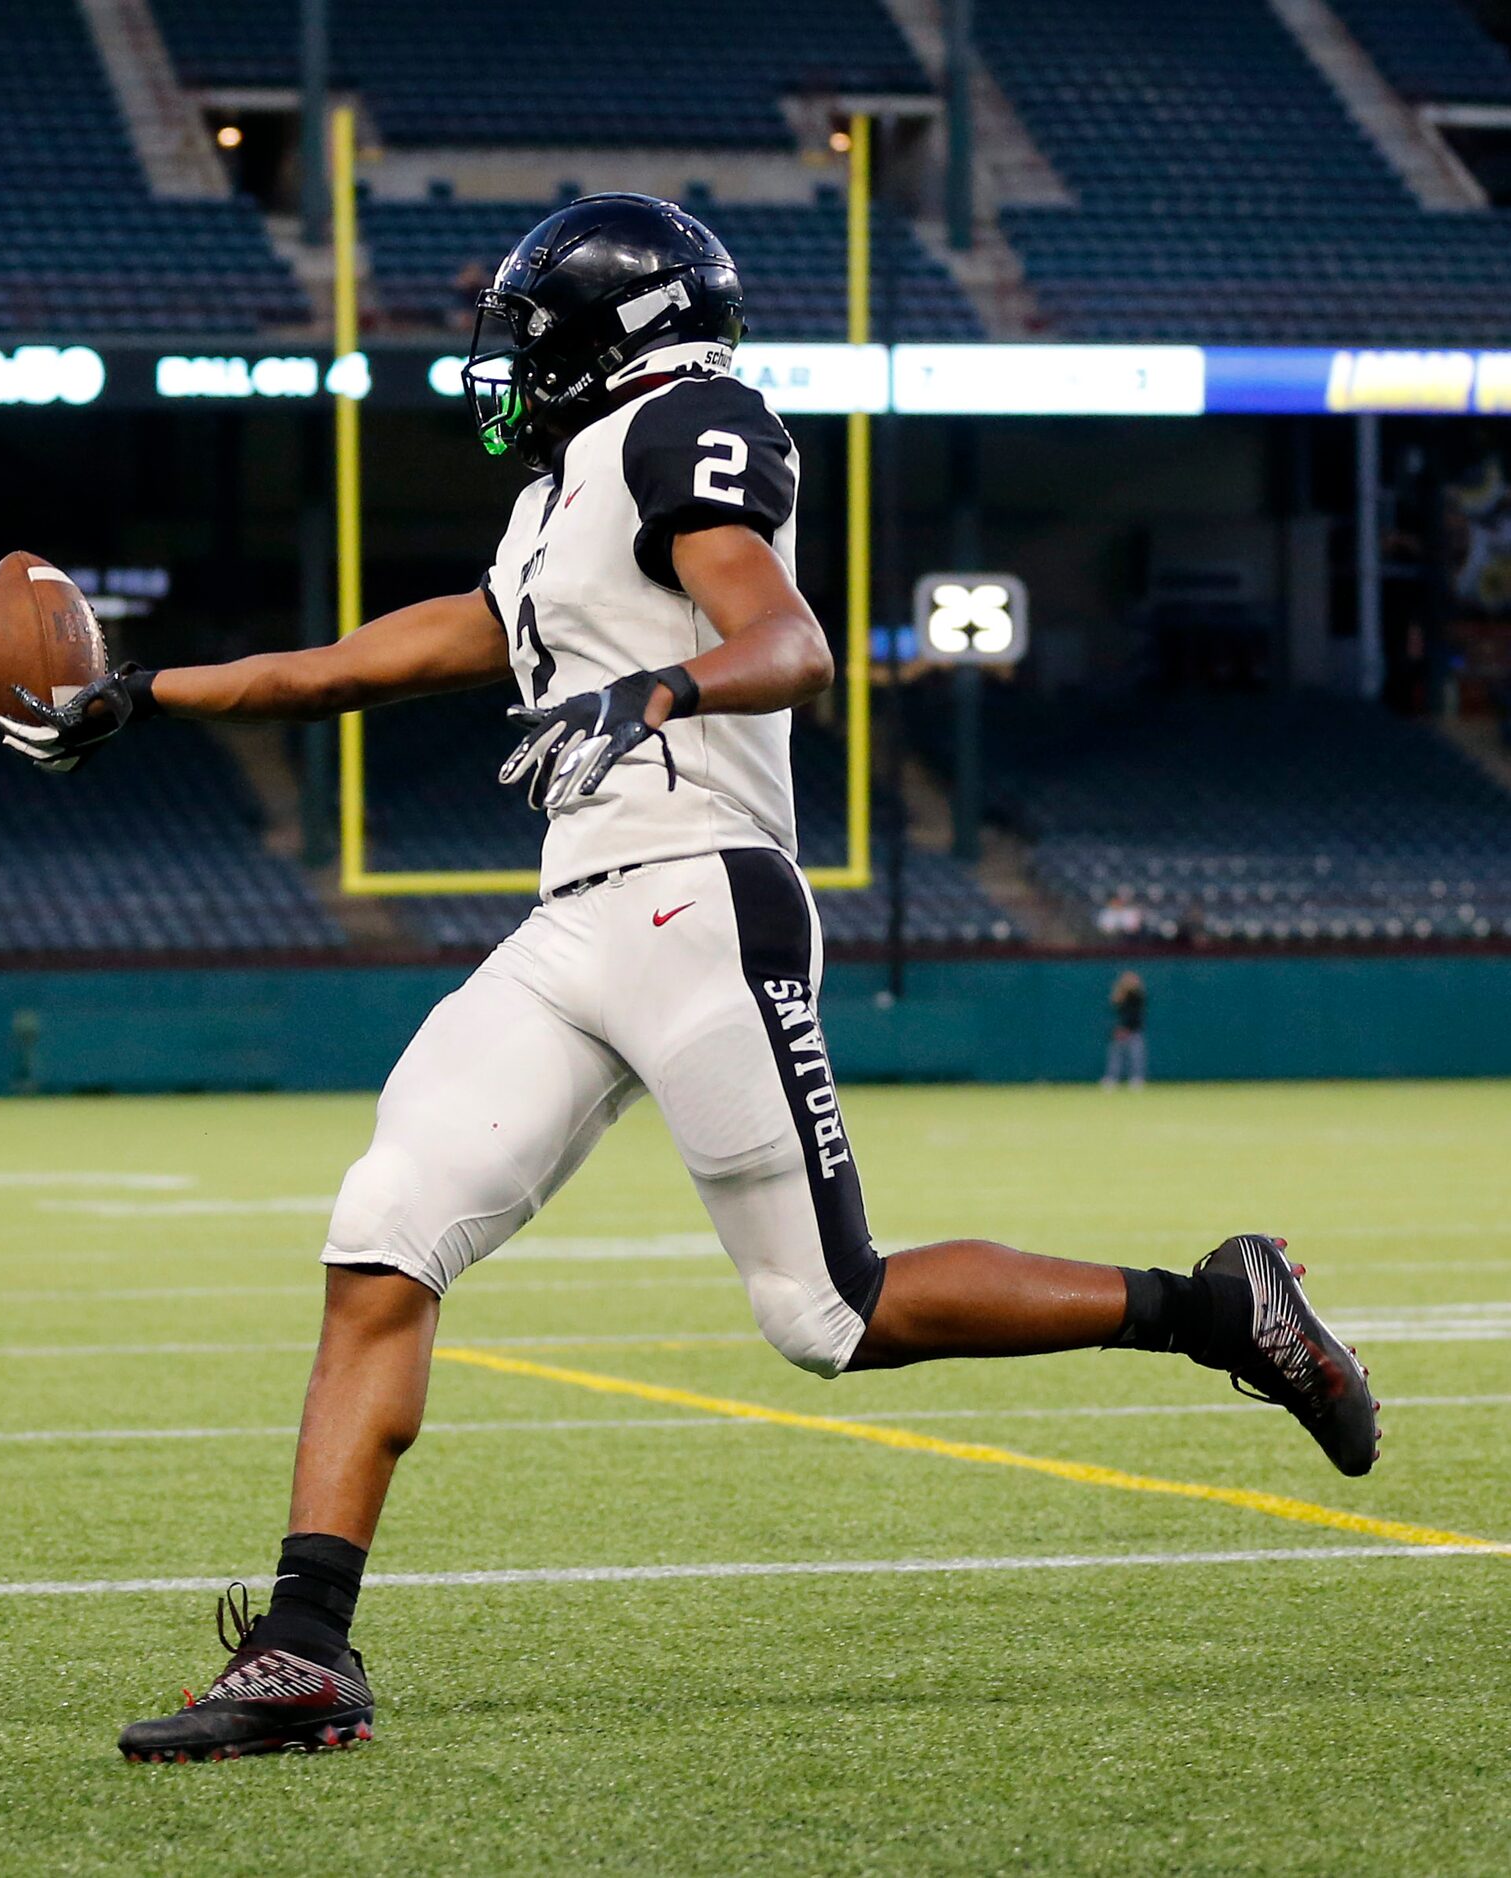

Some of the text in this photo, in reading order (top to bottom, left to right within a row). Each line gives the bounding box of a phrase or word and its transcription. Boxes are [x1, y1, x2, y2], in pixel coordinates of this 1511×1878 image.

[325, 351, 371, 400] 4
[693, 429, 749, 506] 2
[763, 978, 850, 1180] TROJANS
